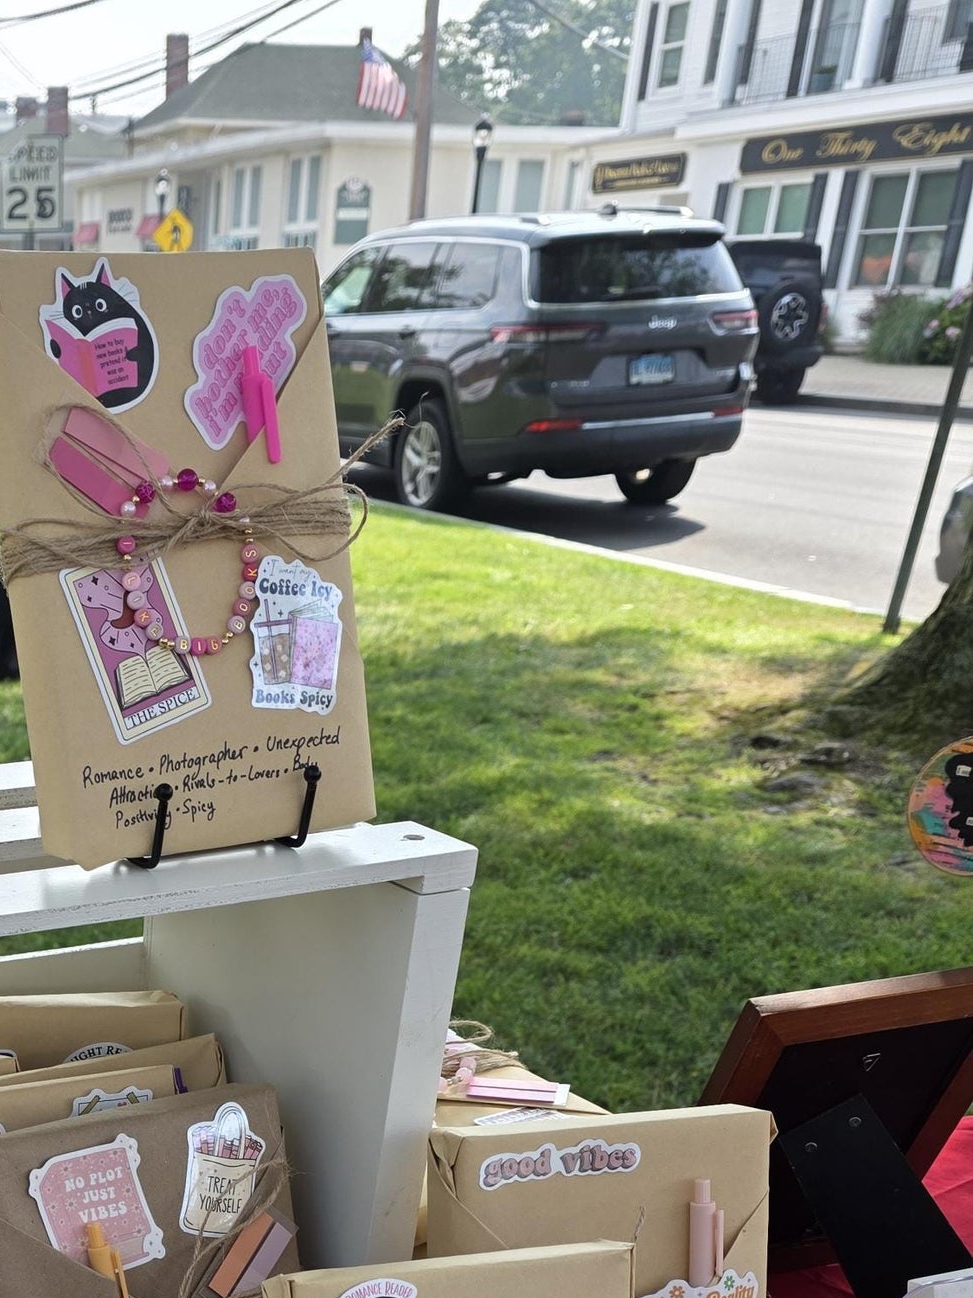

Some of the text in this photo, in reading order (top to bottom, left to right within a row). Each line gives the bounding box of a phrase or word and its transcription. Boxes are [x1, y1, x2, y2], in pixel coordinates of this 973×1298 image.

[762, 138, 804, 164] One
[816, 131, 877, 162] Thirty
[6, 185, 56, 220] 25
[179, 639, 221, 651] BIG
[232, 547, 258, 631] BOOKS
[258, 577, 334, 601] Coffee Icy
[126, 688, 196, 727] THE SPICE
[255, 688, 334, 709] Books Spicy
[82, 725, 342, 789] Romance Photographer Unexpected
[182, 765, 280, 794] Rivals-to-Lovers
[182, 799, 217, 823] Spicy
[63, 1166, 124, 1193] NO PLOT
[483, 1145, 638, 1187] good vibes
[82, 1186, 116, 1204] JUST
[207, 1175, 239, 1194] TREAT
[78, 1201, 128, 1224] VIBES
[199, 1193, 242, 1214] YOURSELF
